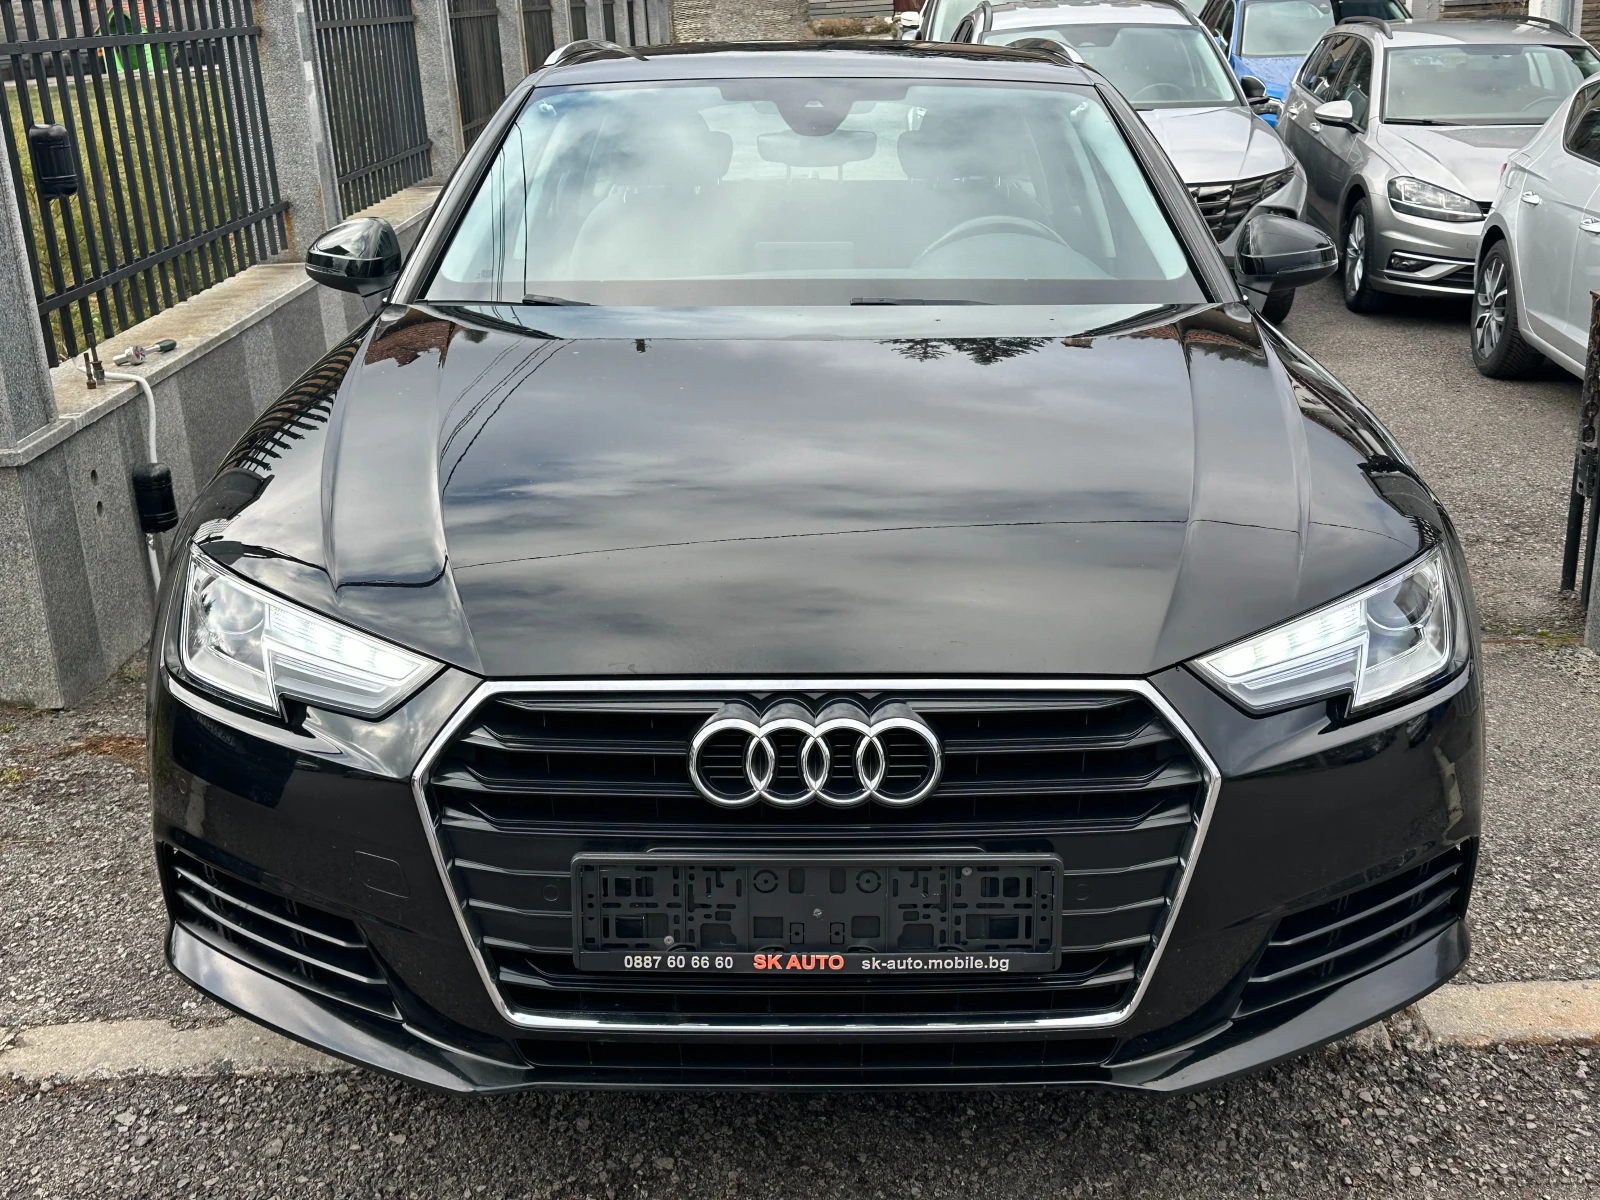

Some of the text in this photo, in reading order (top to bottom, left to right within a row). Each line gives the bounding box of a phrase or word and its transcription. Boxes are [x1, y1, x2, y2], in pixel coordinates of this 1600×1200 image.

[624, 954, 1010, 971] 0887 60 66 60 SK AUTO sk-auto.mobile.bg
